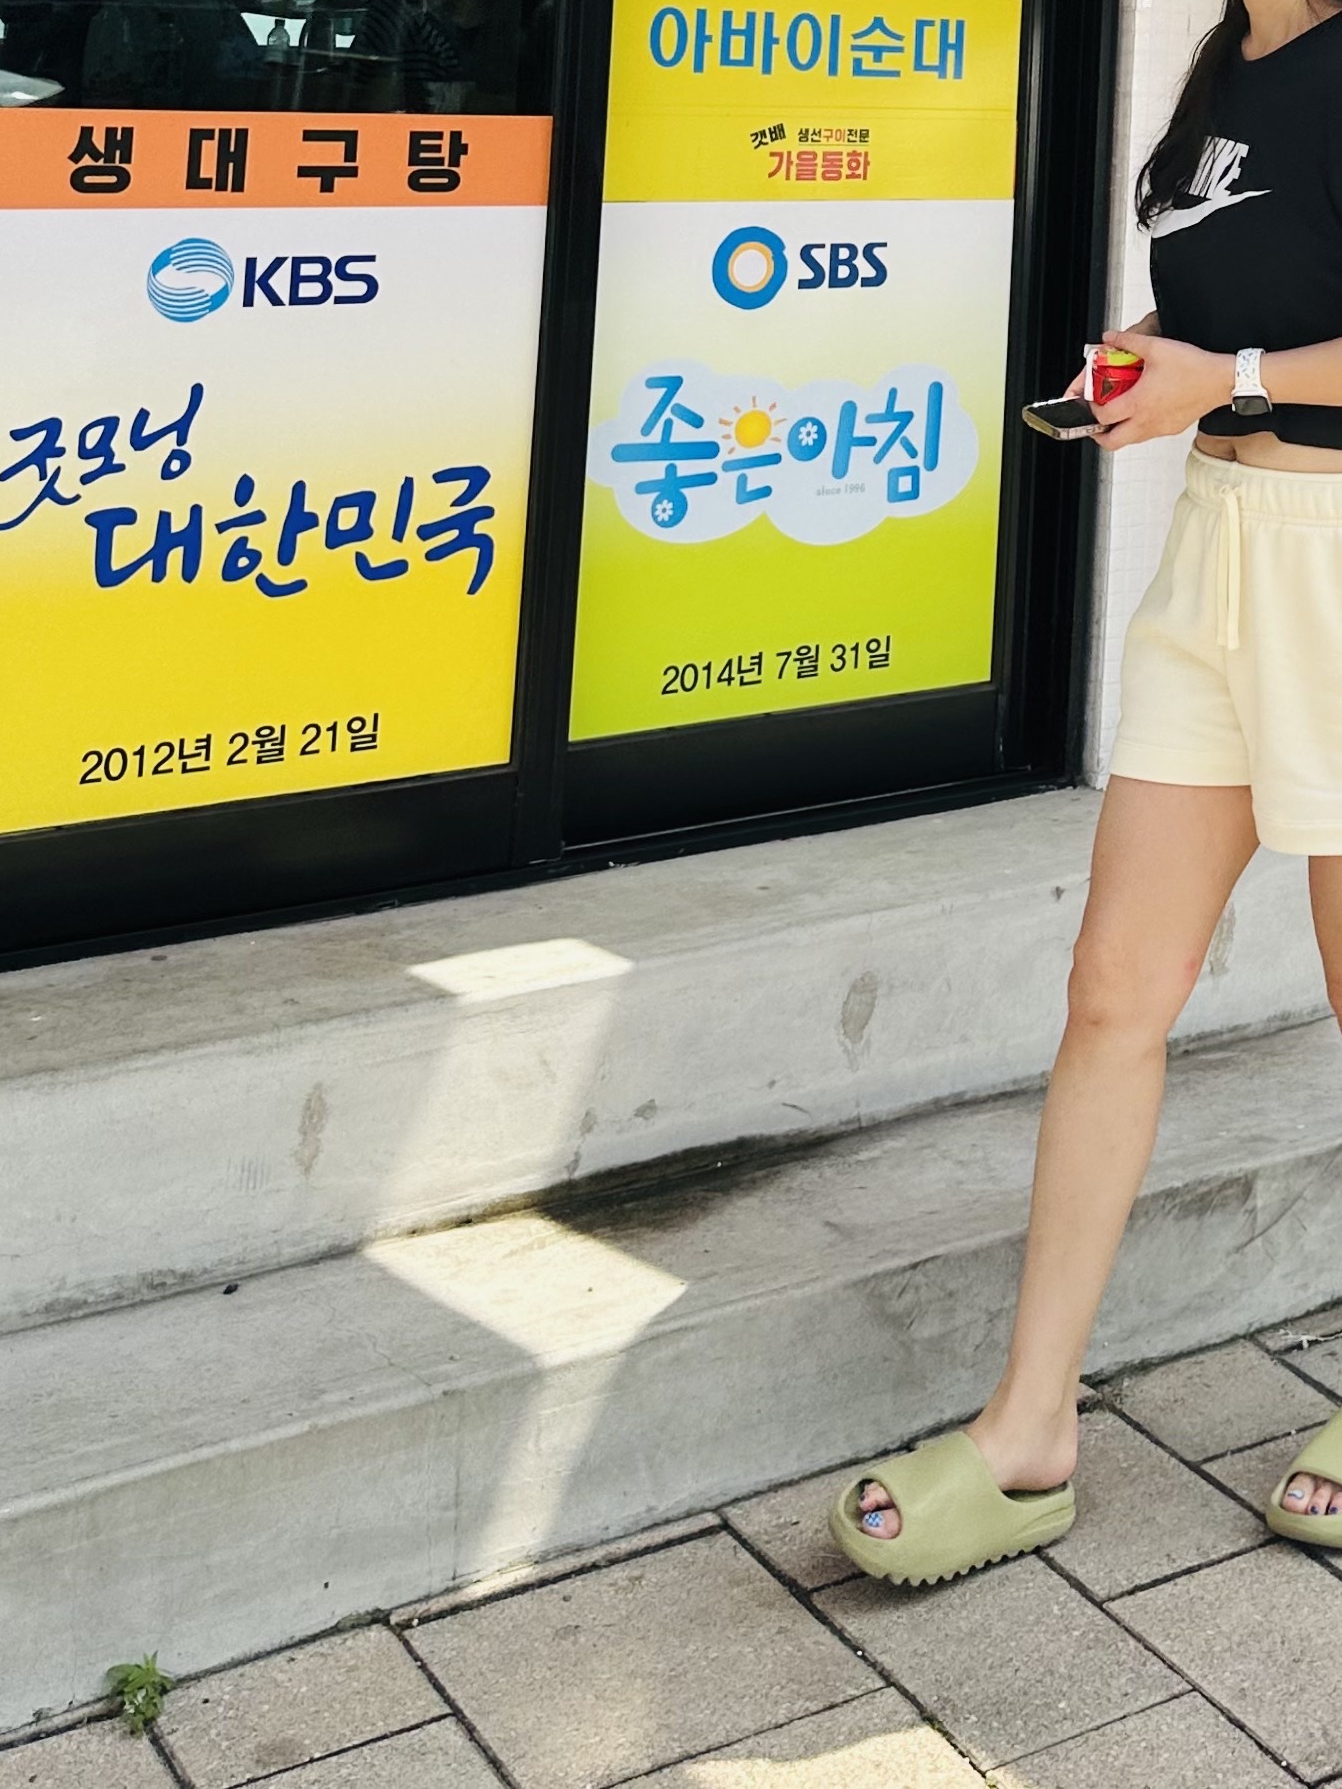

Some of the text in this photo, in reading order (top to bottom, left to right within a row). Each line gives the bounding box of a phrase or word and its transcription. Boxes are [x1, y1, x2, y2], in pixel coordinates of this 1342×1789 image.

[649, 6, 965, 80] 아바이순대
[750, 124, 787, 149] 갯배
[798, 128, 870, 144] 생선구이전문
[767, 150, 871, 181] 가을동화
[242, 254, 380, 308] KBS
[798, 242, 888, 290] SBS
[84, 466, 496, 597] 대한민국
[661, 635, 892, 695] 2014년 7월 31일
[79, 713, 380, 784] 2012년 2월 21일
